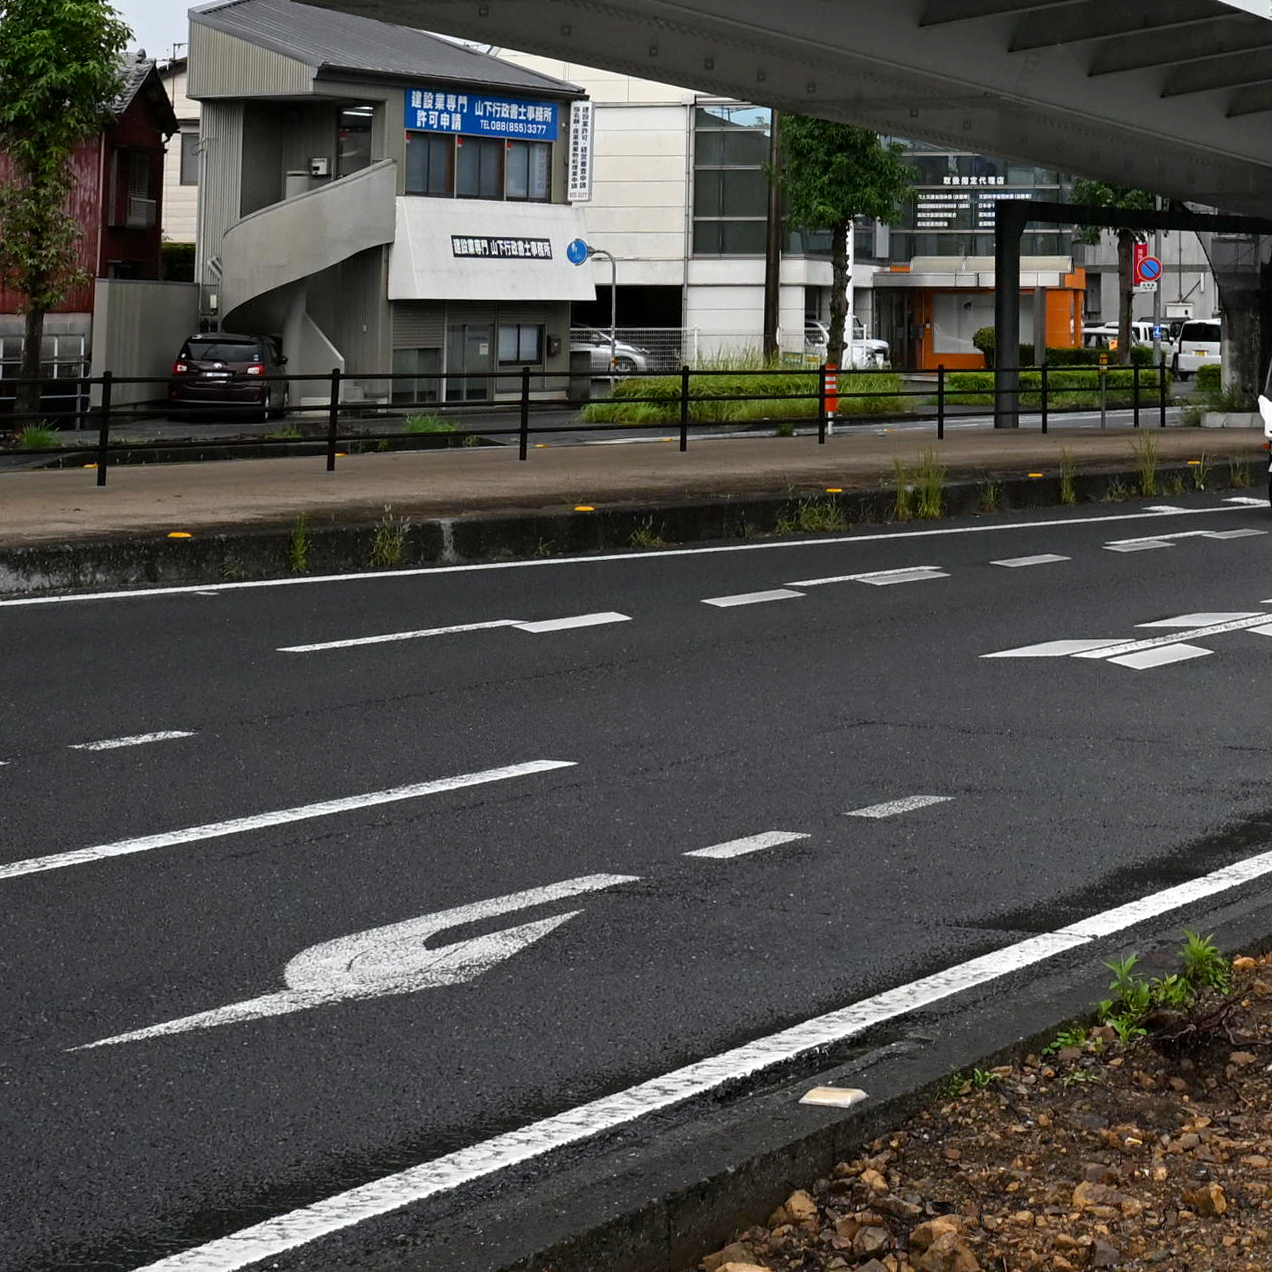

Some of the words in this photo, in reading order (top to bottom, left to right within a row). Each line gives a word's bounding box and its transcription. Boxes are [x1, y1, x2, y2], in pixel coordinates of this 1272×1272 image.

[411, 91, 468, 114] 建設業専門
[474, 101, 553, 123] 山下行政書士事務所
[416, 110, 462, 131] 許可申請
